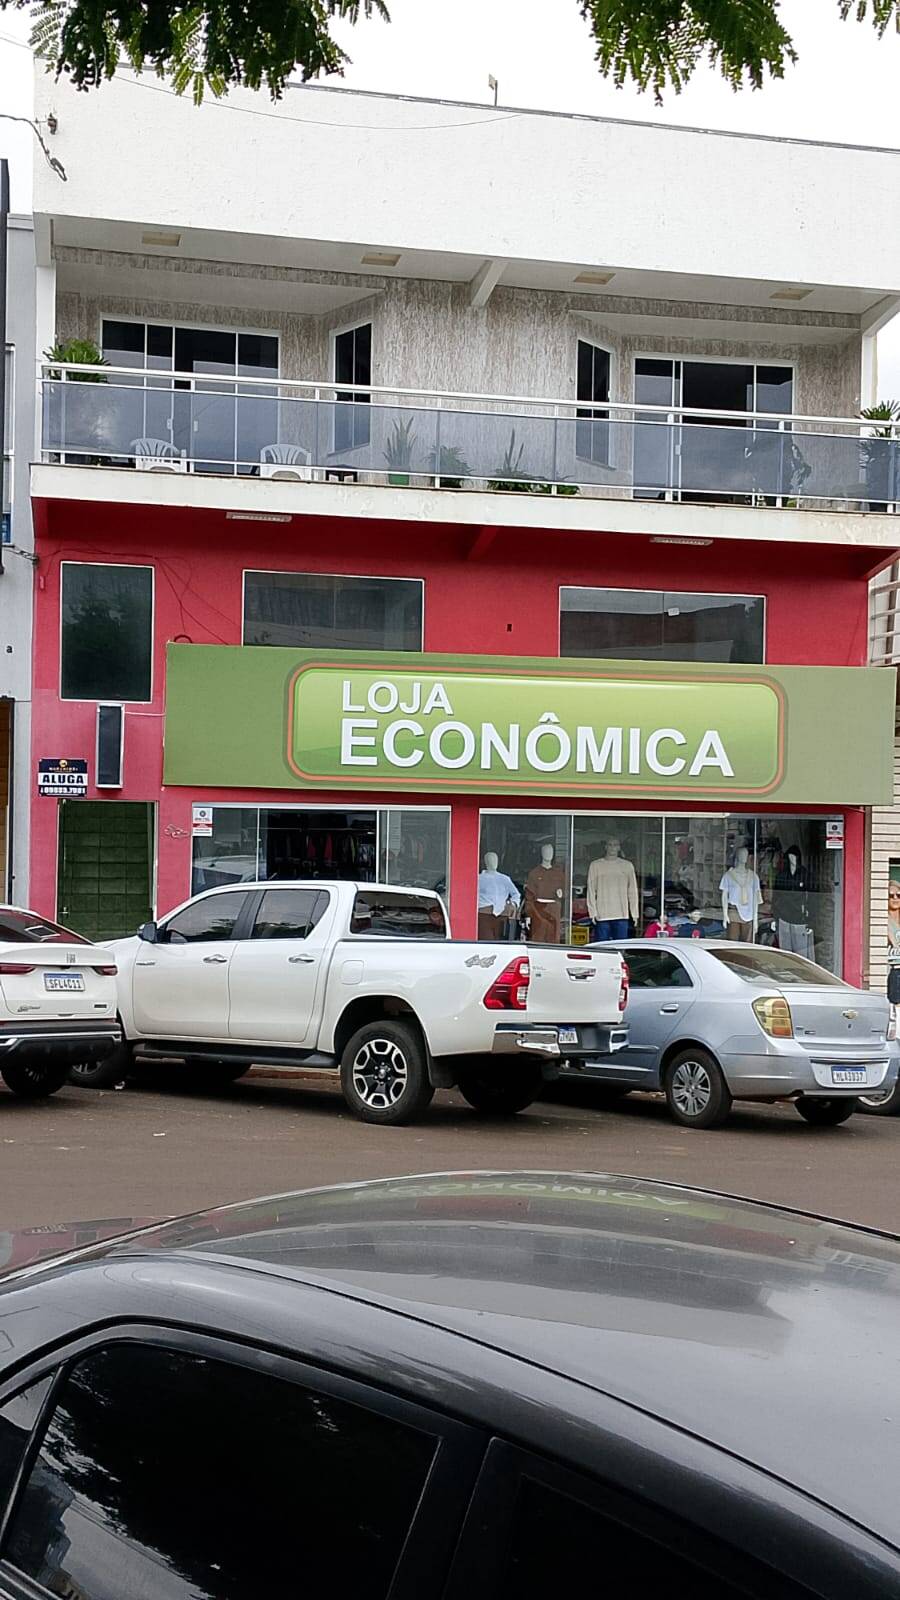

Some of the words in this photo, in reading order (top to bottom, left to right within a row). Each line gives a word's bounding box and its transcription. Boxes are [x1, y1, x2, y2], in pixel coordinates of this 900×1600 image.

[342, 680, 454, 715] LOJA
[340, 711, 735, 778] ECONÔMICA
[42, 774, 84, 784] ALUGA
